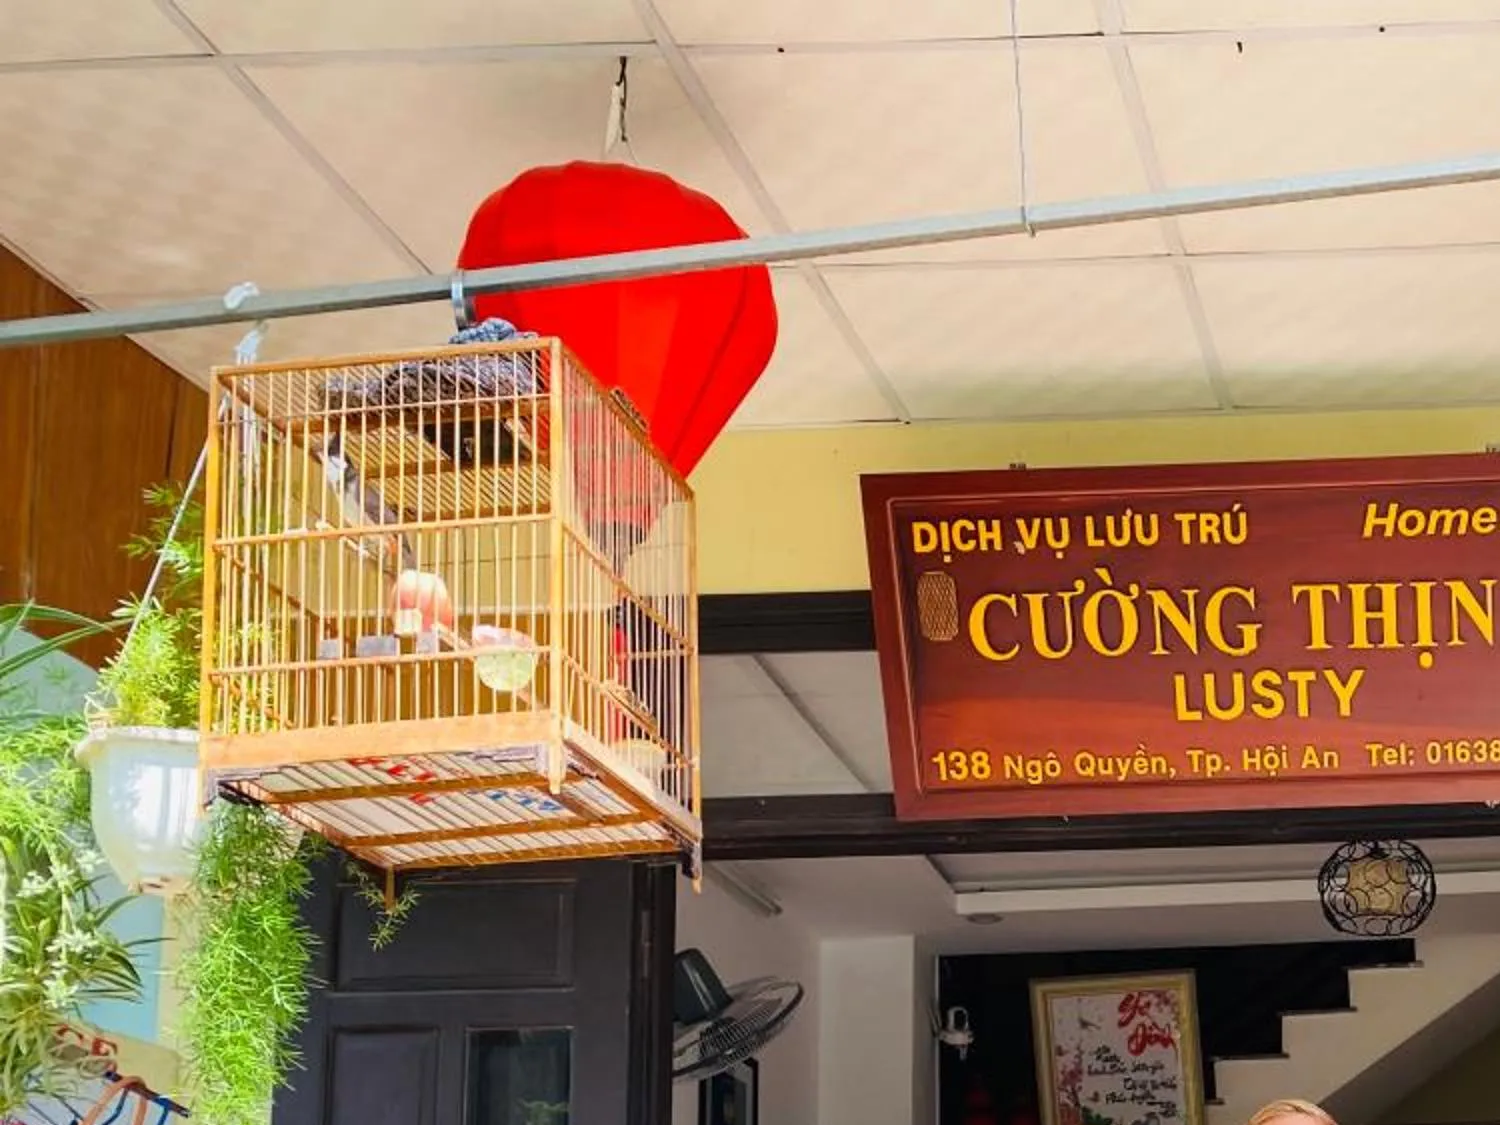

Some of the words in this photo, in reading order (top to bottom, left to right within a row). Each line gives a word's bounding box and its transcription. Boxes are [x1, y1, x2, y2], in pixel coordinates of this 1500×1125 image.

[911, 519, 1002, 563] DỊCH
[1016, 517, 1070, 559] VỤ
[1085, 508, 1159, 547] LƯU
[1174, 503, 1248, 545] TRÚ
[968, 567, 1263, 661] CƯỜNG
[1173, 669, 1365, 721] LUSTY
[932, 750, 991, 781] 138
[1003, 752, 1062, 785] Ngô
[1074, 743, 1177, 781] Quyền,
[1187, 749, 1231, 777] Tp.
[1242, 745, 1289, 775] Hội
[1301, 745, 1340, 769] An
[1366, 743, 1415, 768] Tel:
